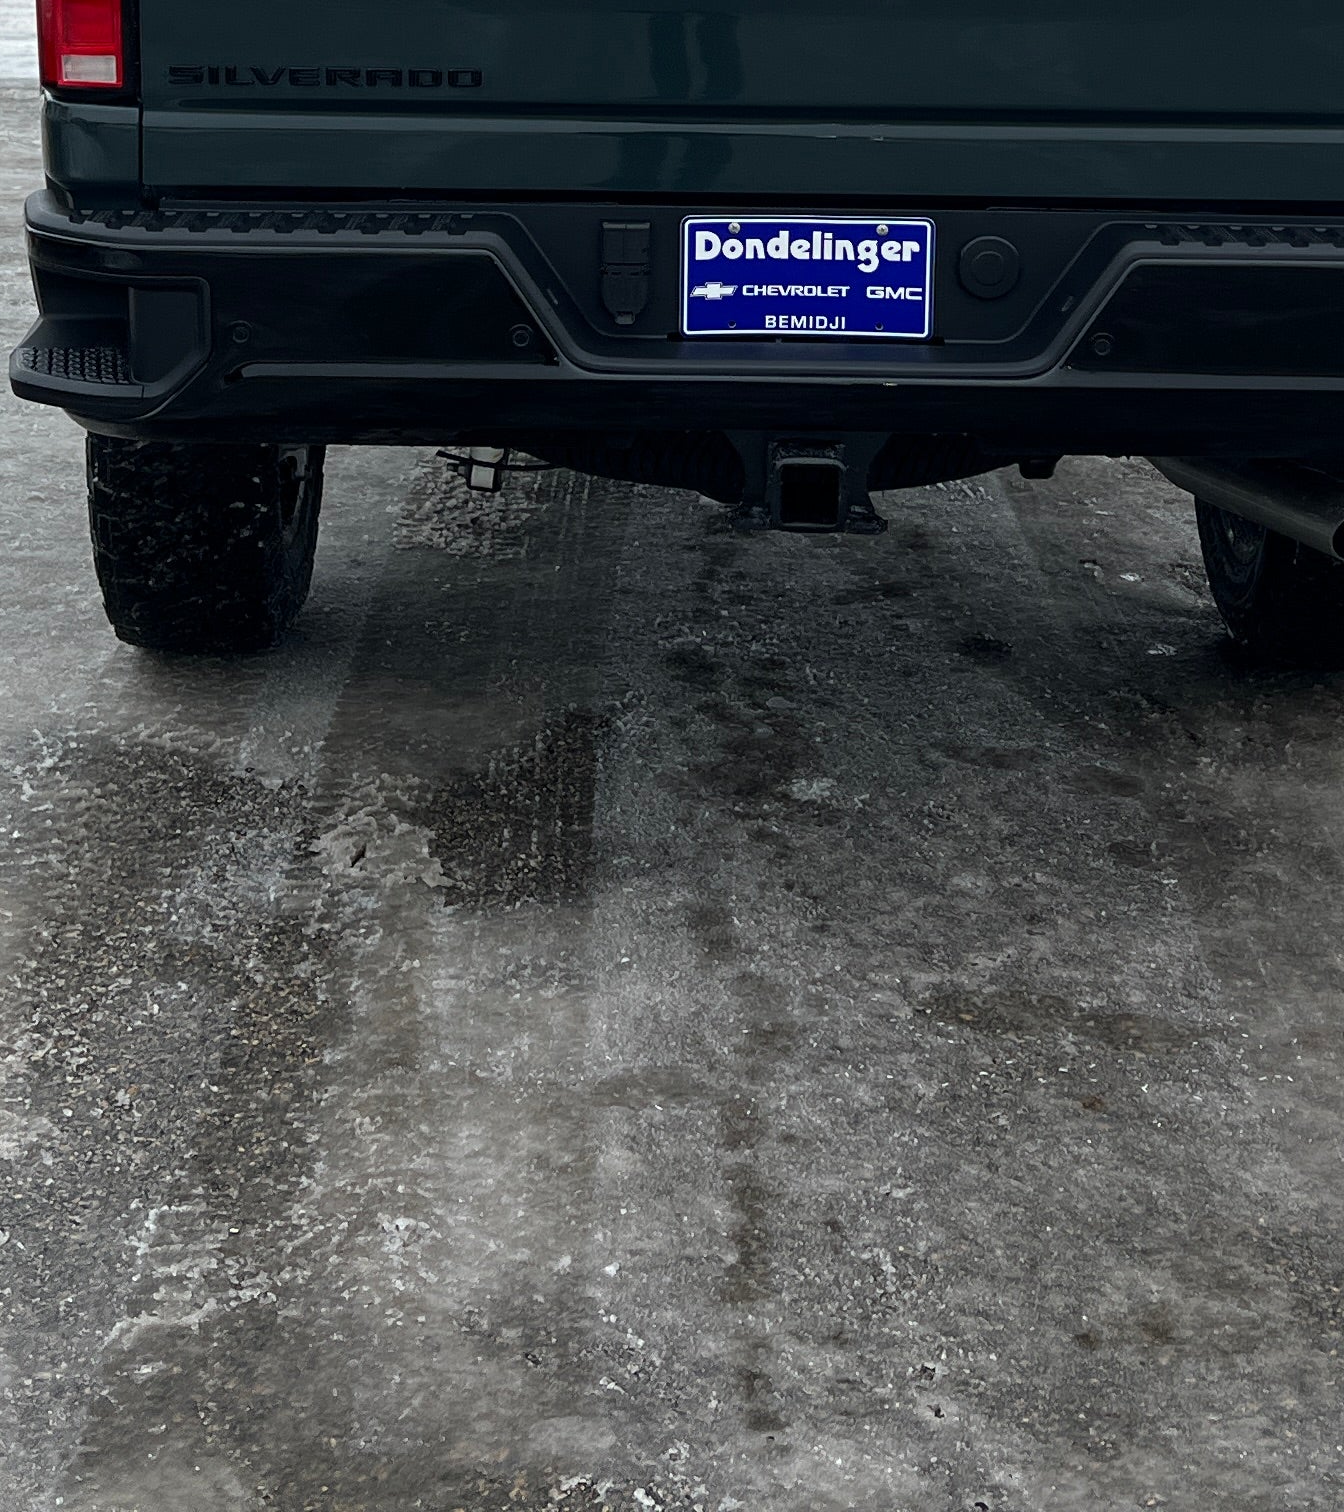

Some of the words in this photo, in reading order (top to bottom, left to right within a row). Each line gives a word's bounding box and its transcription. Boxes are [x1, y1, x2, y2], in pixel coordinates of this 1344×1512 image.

[168, 64, 484, 88] SILVERADO
[694, 230, 921, 274] Dondelinger
[741, 284, 851, 298] CHEVROLET
[865, 286, 923, 301] GMC
[764, 314, 847, 330] BEMIDJI
